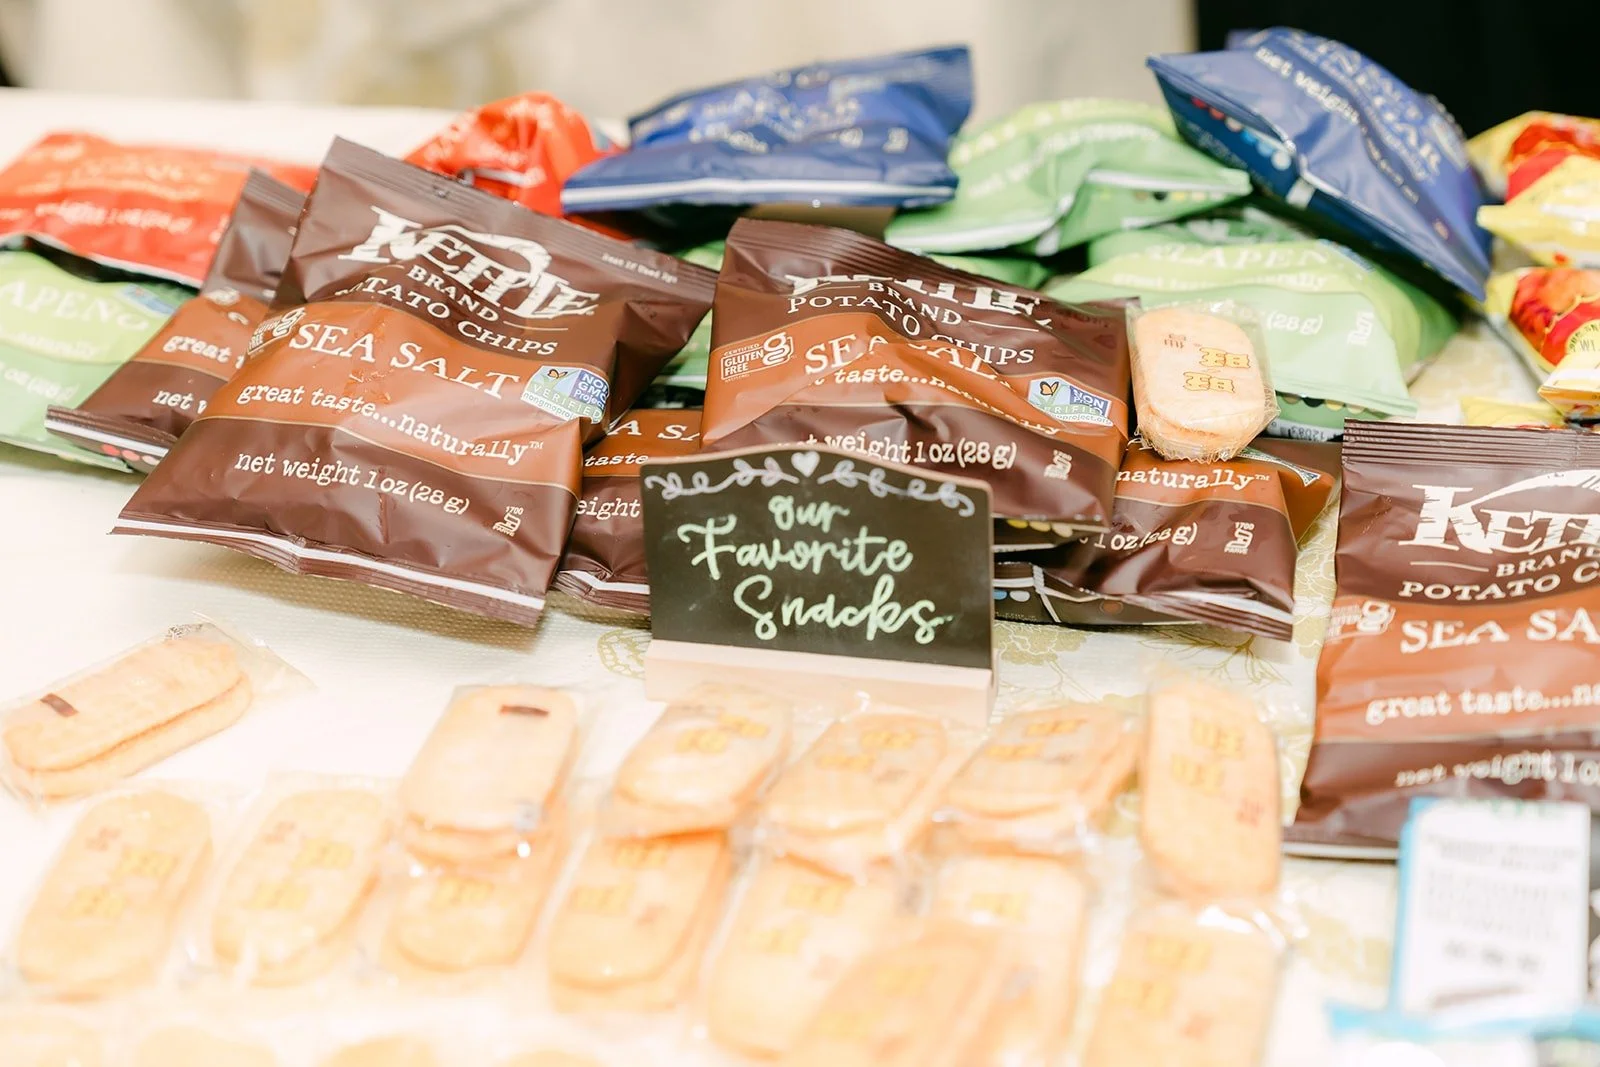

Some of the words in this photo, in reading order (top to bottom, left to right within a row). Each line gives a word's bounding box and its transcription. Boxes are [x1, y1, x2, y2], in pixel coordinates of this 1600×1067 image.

[338, 205, 599, 319] KETTLE
[407, 265, 499, 322] BRAND
[868, 281, 963, 326] BRAND
[336, 276, 451, 319] TATO
[457, 321, 558, 356] CHIPS
[787, 295, 921, 337] POTATO
[163, 335, 232, 363] great
[290, 323, 376, 363] SEA
[391, 341, 520, 399] SALT
[724, 349, 764, 368] GLUTEN
[724, 362, 749, 377] FREE
[906, 342, 1016, 393] AL
[153, 388, 194, 411] net
[237, 383, 304, 403] great
[532, 384, 602, 418] VERIFIED
[1073, 388, 1105, 408] NON
[584, 452, 649, 467] taste
[825, 431, 911, 463] weight
[234, 451, 274, 476] net
[282, 458, 362, 487] weight
[505, 506, 524, 515] 1700
[576, 496, 641, 520] eight
[1234, 521, 1255, 531] 1700
[1397, 470, 1600, 554] KET
[677, 514, 914, 580] Favorite
[1398, 578, 1562, 601] POTATO
[733, 574, 954, 645] Snacks
[1400, 620, 1510, 655] SEA
[1526, 606, 1600, 645] SA
[1365, 691, 1452, 726] great
[1458, 683, 1600, 715] taste...n
[1394, 763, 1447, 788] net
[1452, 749, 1557, 786] weight
